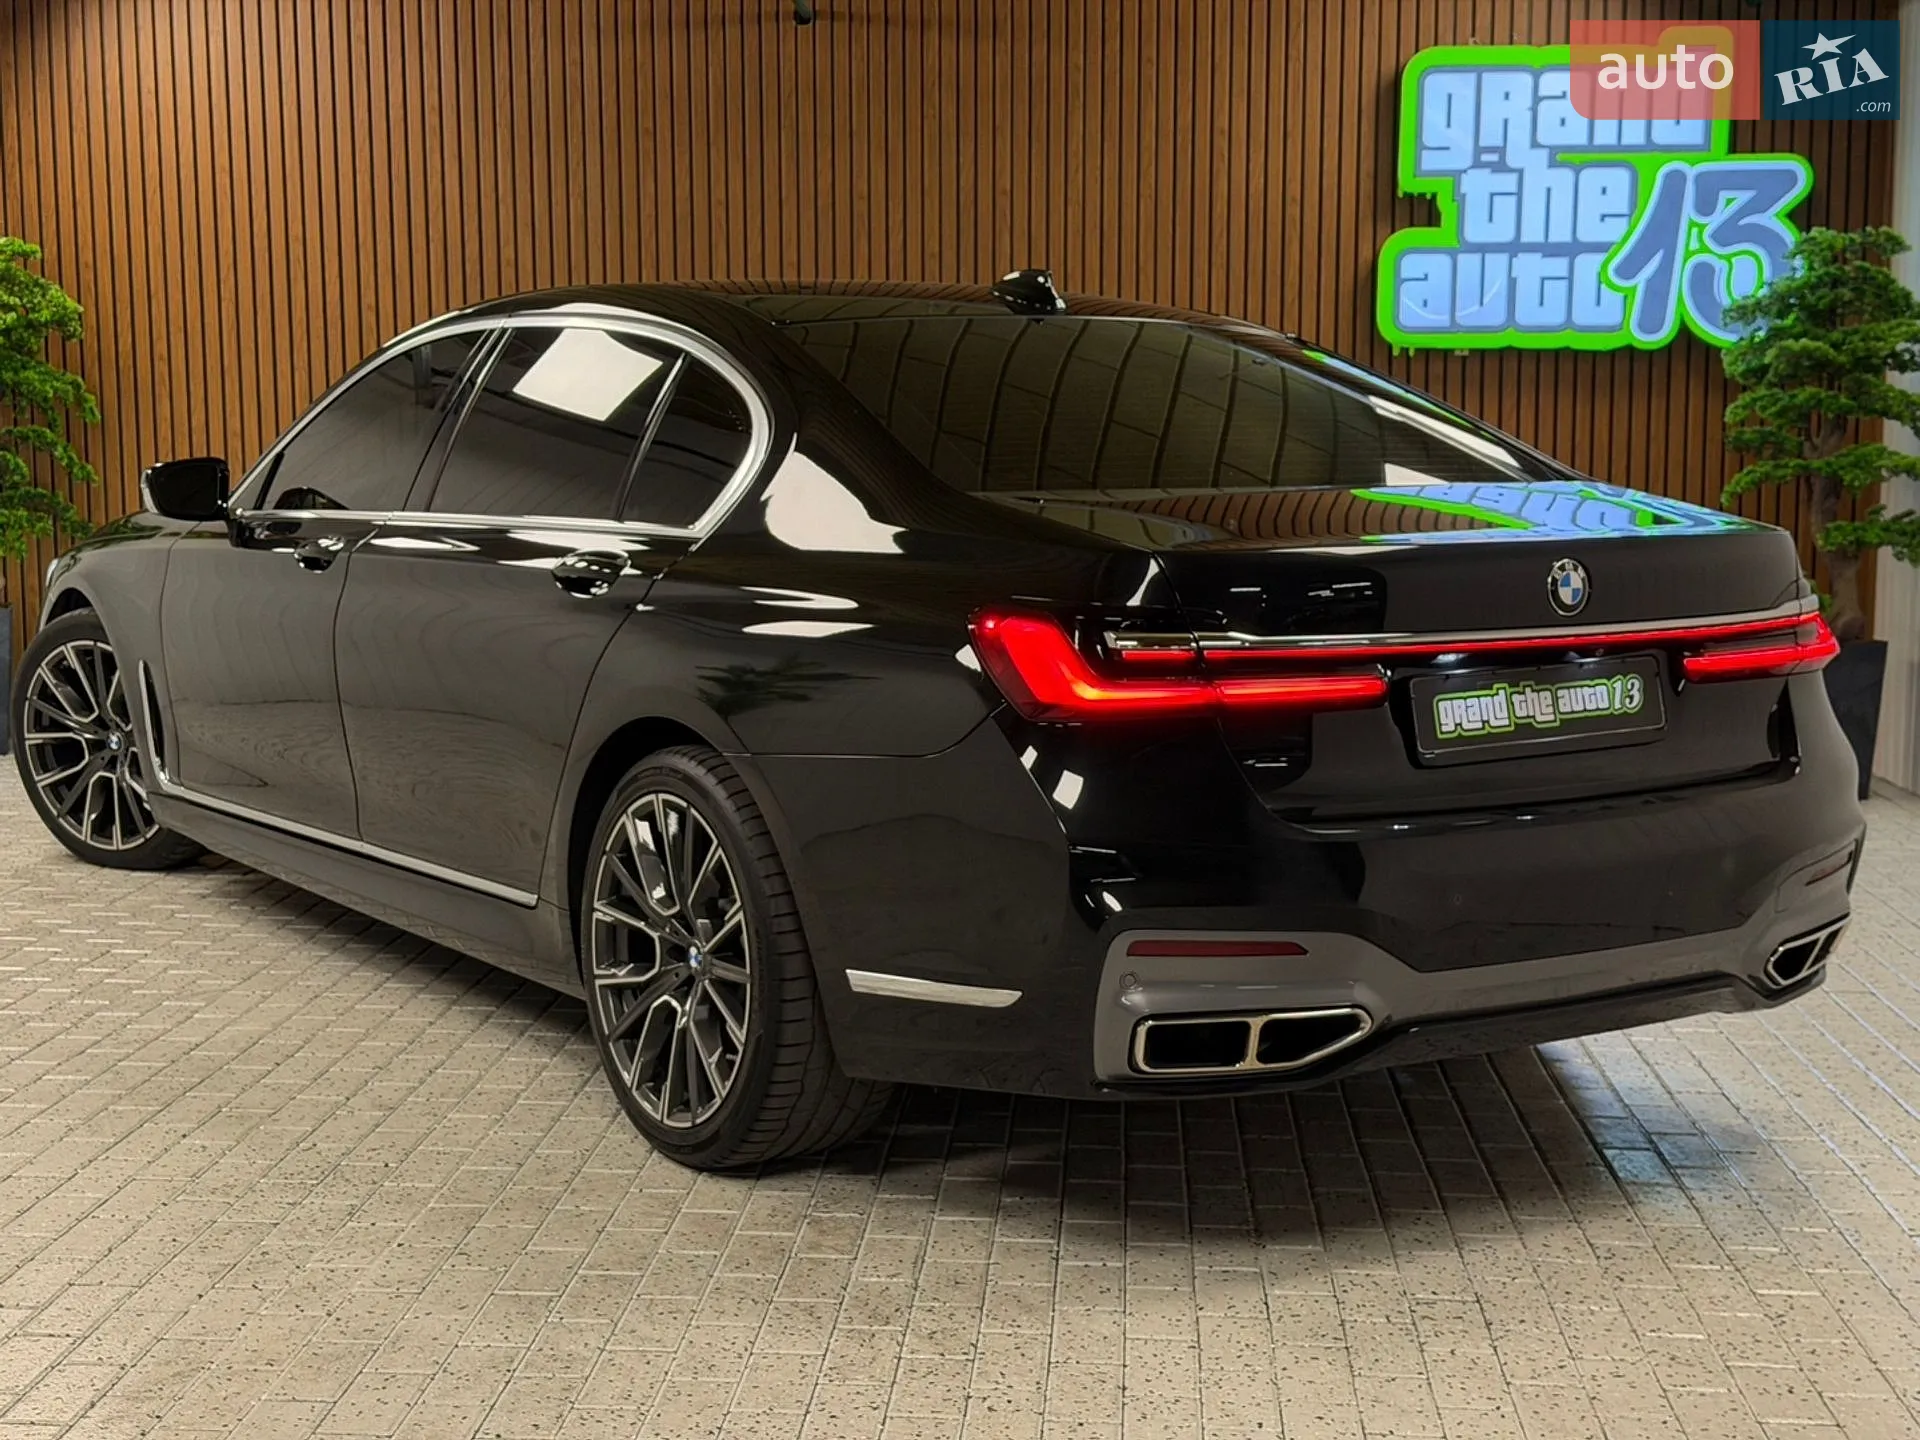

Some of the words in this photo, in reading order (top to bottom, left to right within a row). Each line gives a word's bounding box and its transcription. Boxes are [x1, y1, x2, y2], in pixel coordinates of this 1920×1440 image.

[1459, 149, 1631, 244] the
[1608, 160, 1804, 342] 13
[1512, 687, 1555, 722] the
[1557, 685, 1610, 713] auto
